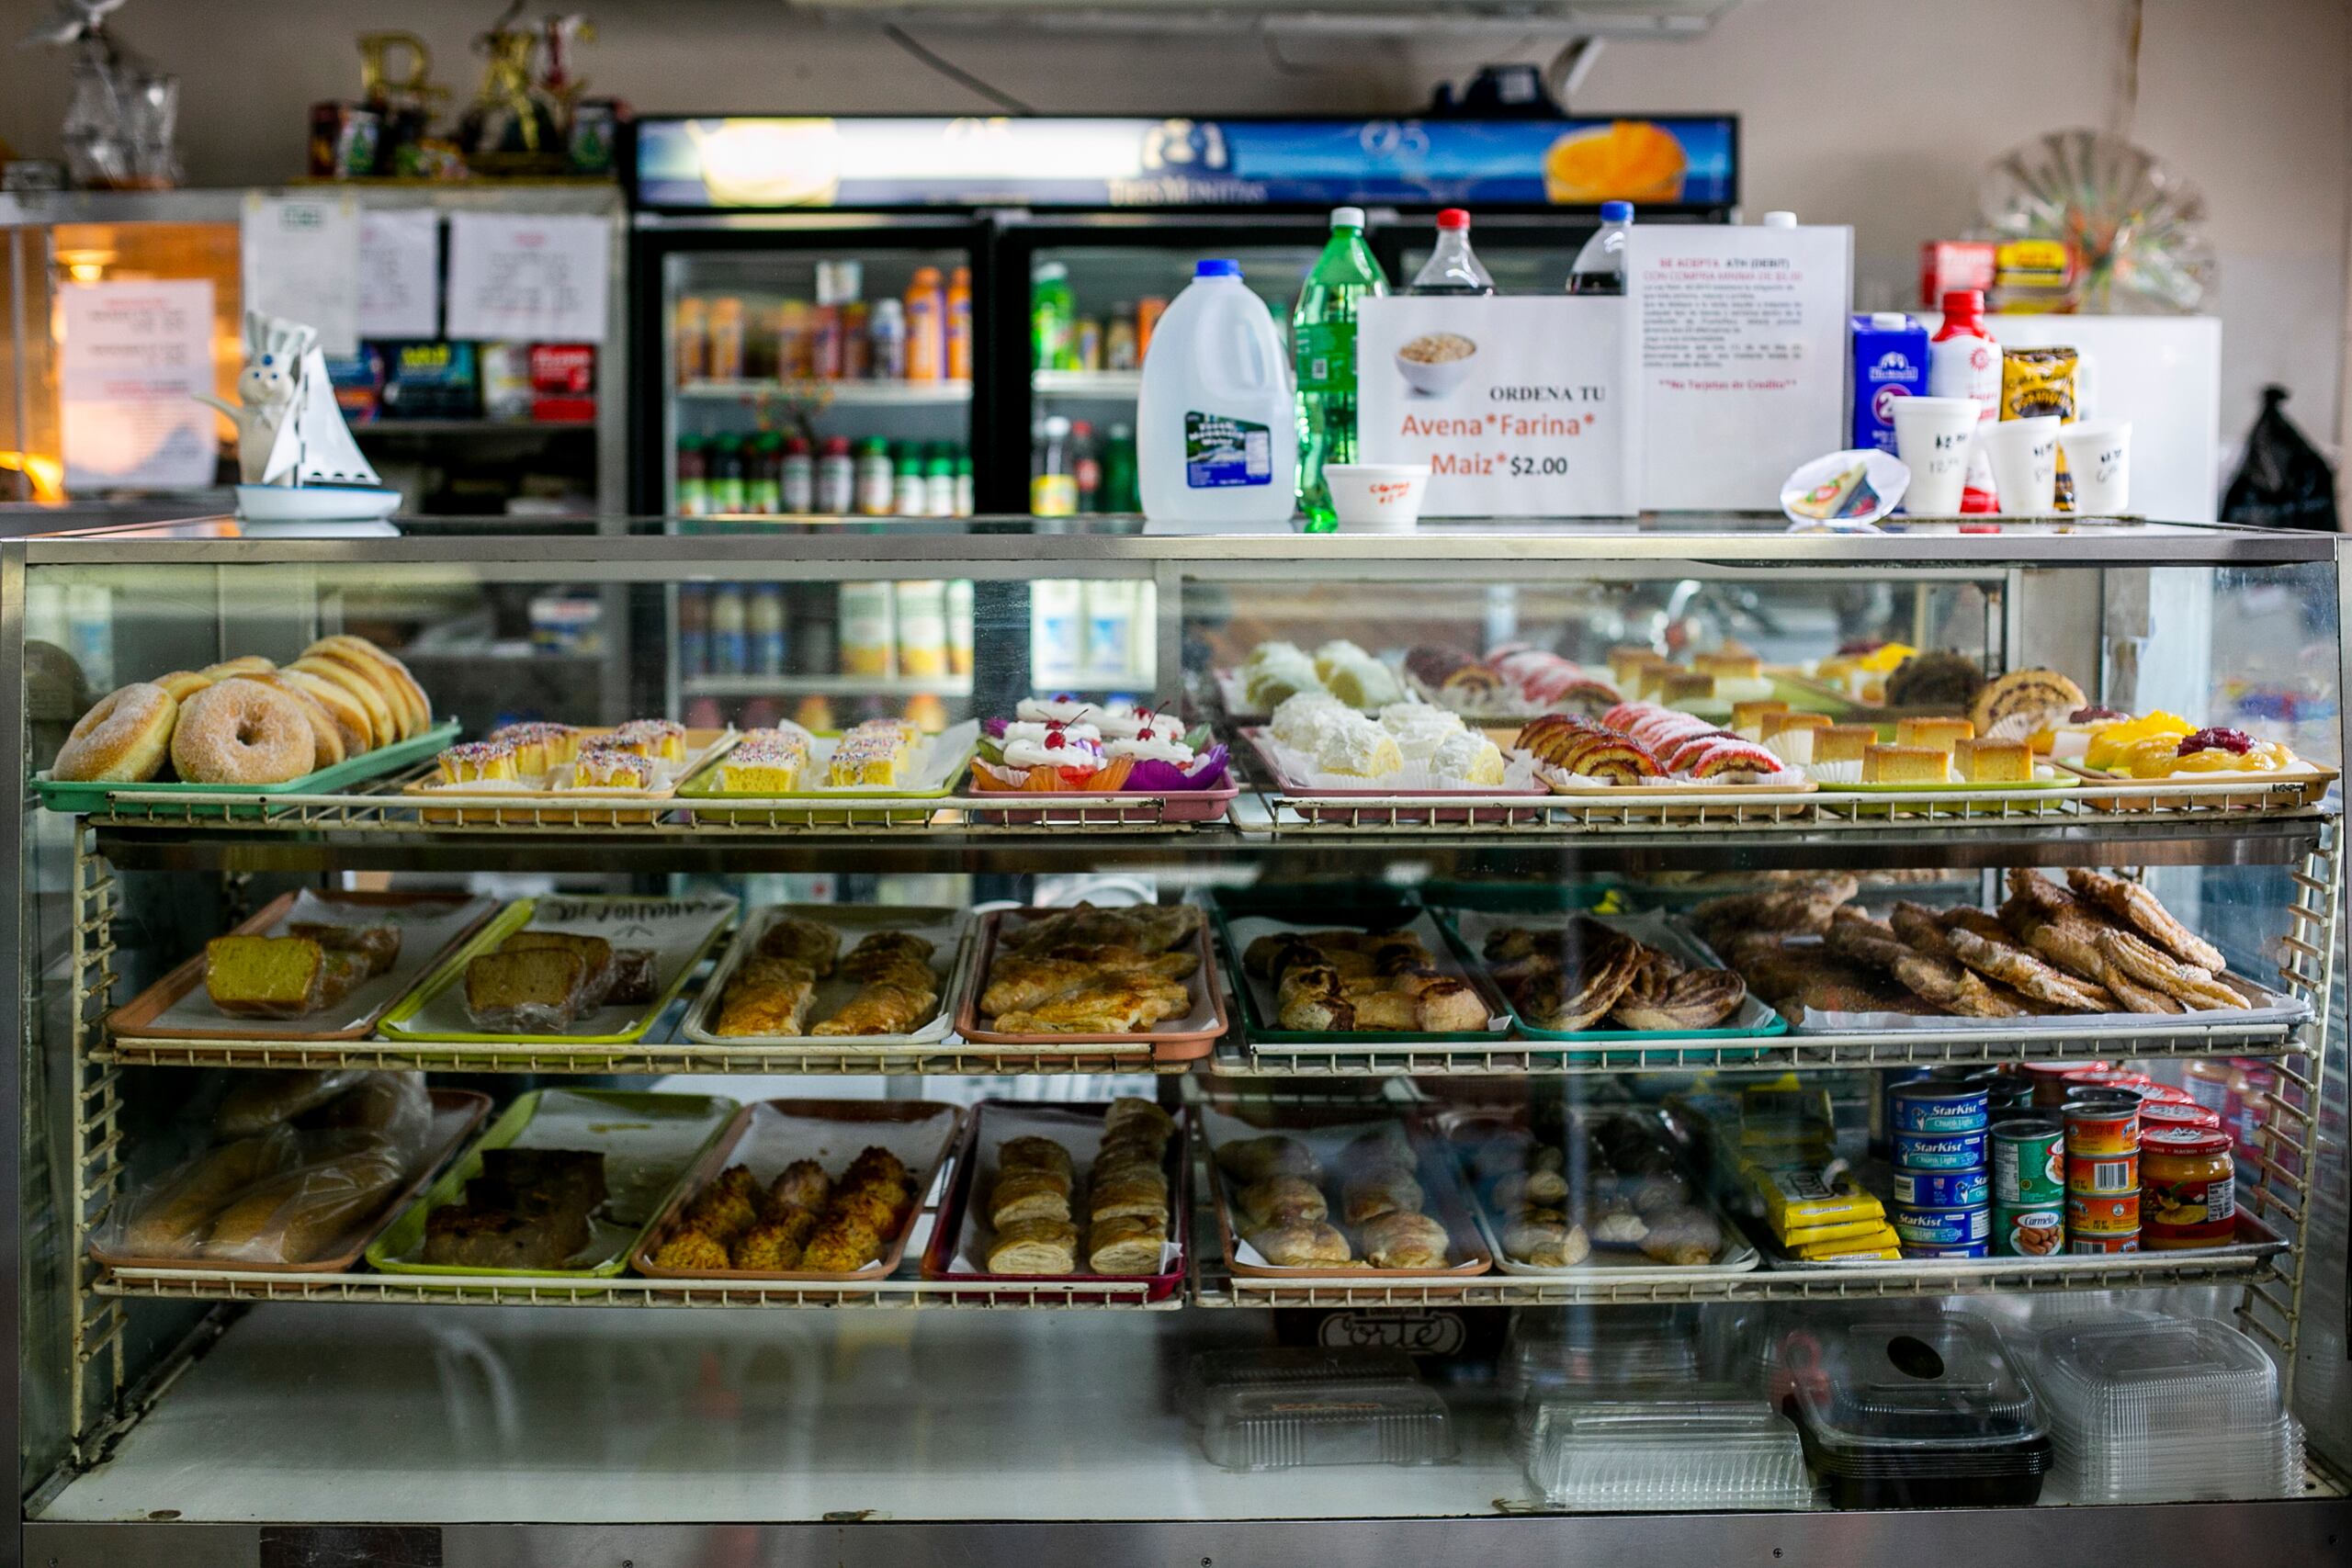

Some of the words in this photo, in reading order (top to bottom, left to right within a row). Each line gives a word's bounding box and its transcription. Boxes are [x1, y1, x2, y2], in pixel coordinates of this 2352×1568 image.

[1490, 386, 1573, 401] ORDENA
[1578, 386, 1606, 401] TU
[1932, 1104, 1977, 1117] StarKist
[1934, 1119, 1959, 1129] Chunk
[1959, 1118, 1973, 1130] Light
[1914, 1142, 1962, 1153] StarKist
[1917, 1156, 1939, 1165] Chunk
[1939, 1156, 1957, 1166] Light
[1899, 1213, 1942, 1227] StarKist
